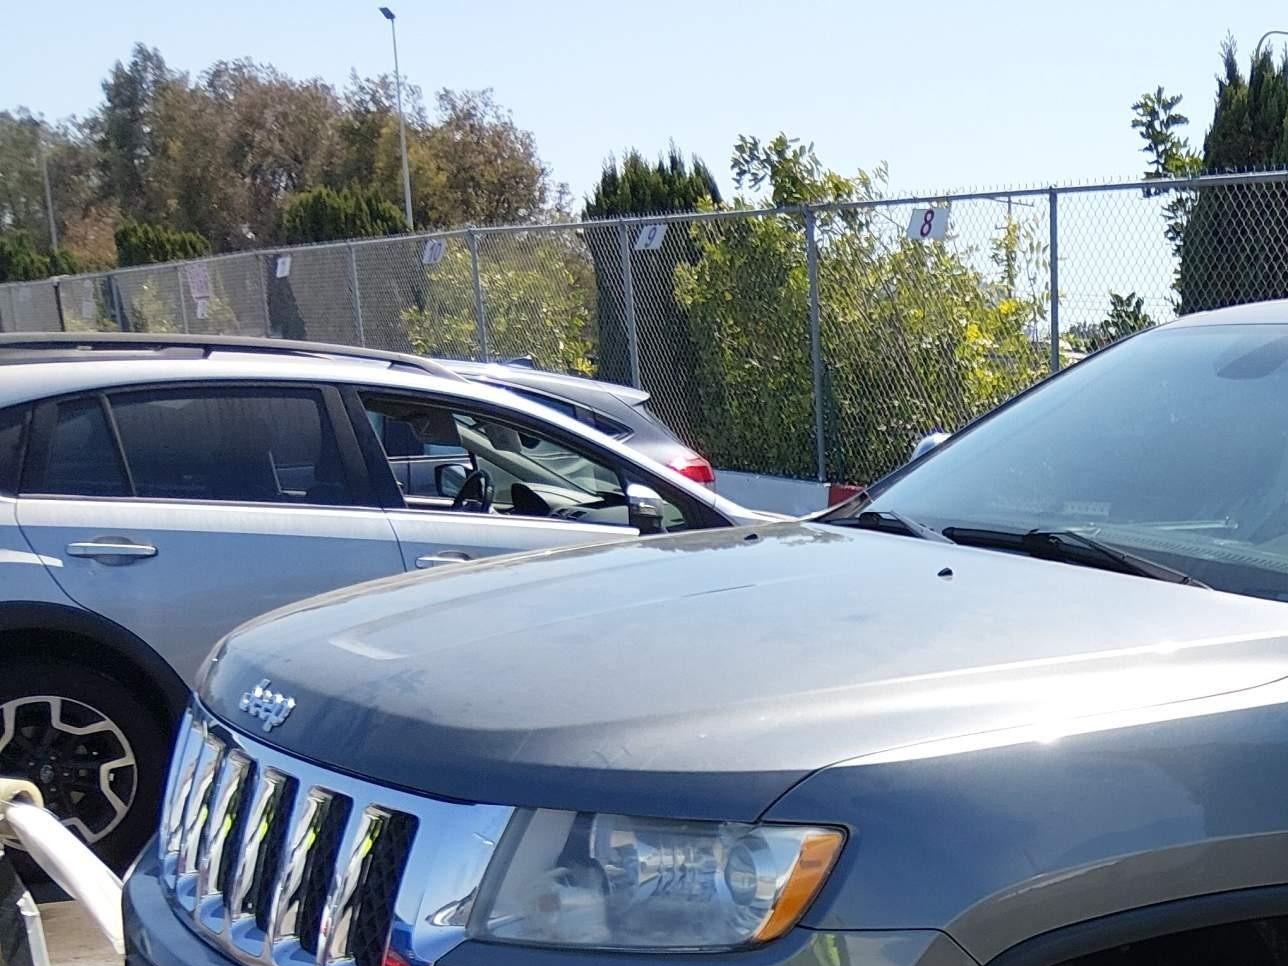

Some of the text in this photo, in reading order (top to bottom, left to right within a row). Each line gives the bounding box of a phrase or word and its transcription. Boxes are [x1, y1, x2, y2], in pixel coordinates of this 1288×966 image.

[645, 226, 657, 248] 9
[920, 209, 935, 238] 8
[240, 678, 296, 733] Jeep
